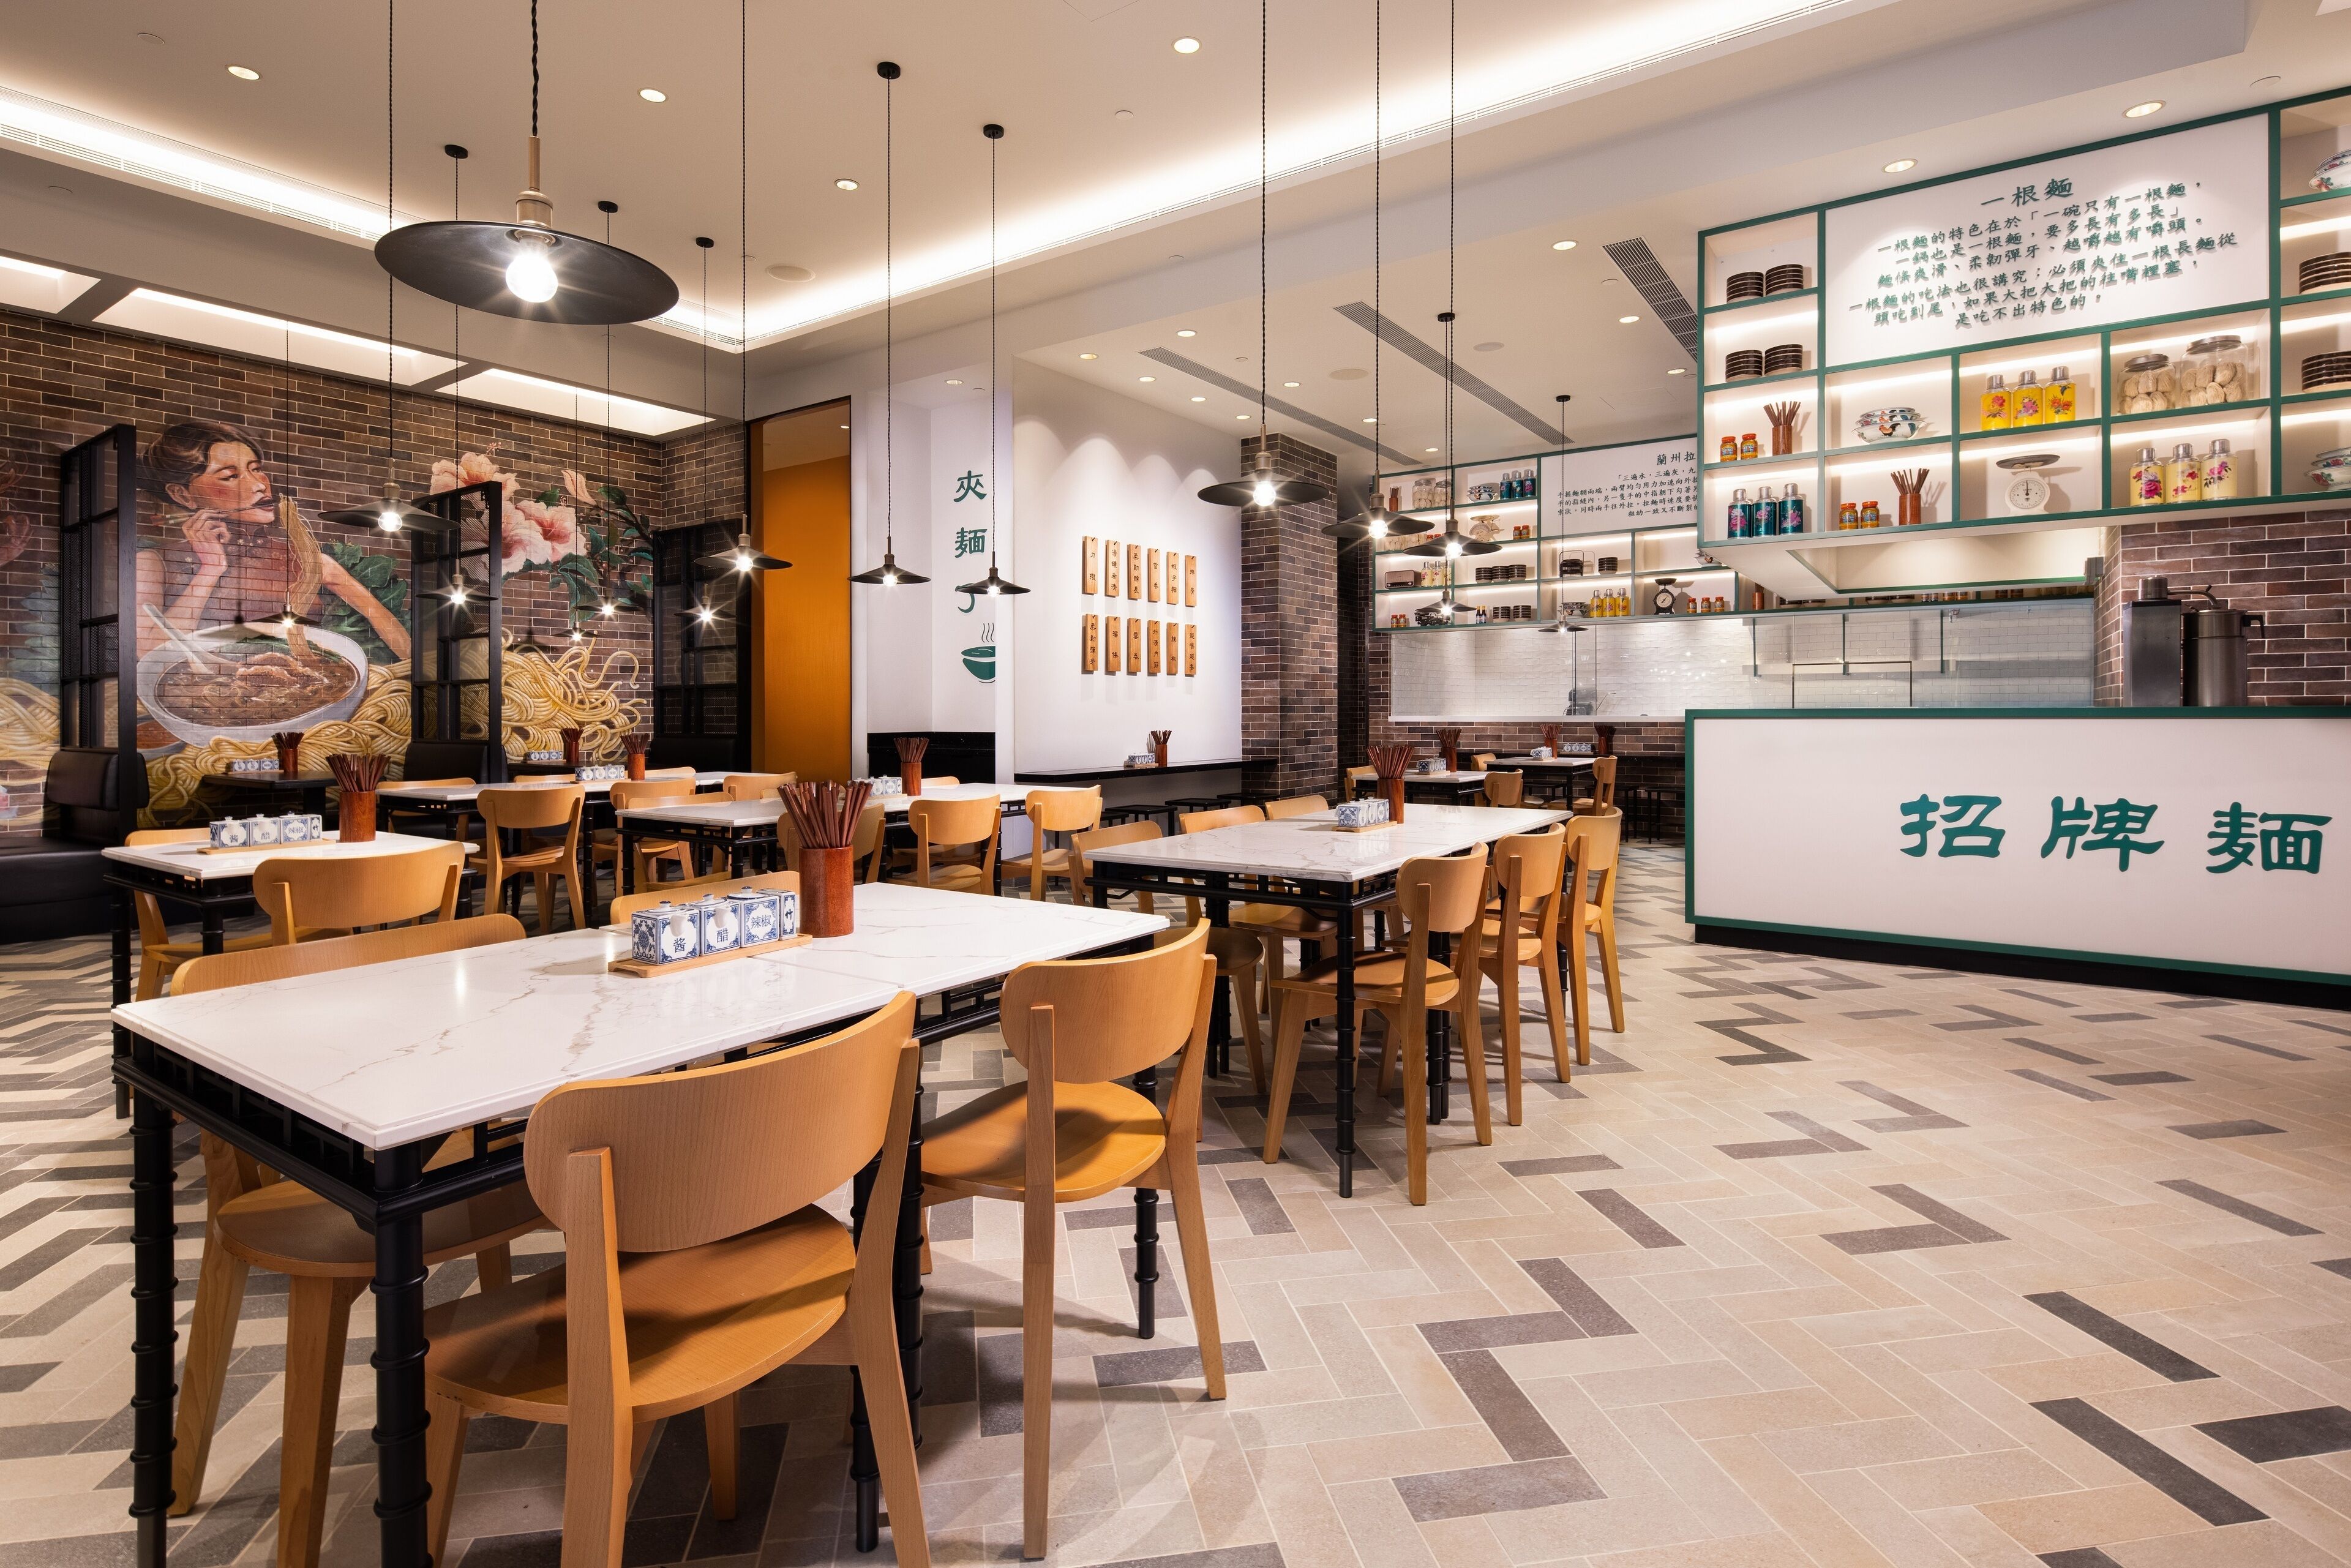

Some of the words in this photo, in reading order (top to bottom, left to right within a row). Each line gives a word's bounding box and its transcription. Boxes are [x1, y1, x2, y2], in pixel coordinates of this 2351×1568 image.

[1981, 178, 2074, 207] 一根麵
[1657, 451, 1696, 465] 蘭州拉
[1900, 793, 2333, 874] 招牌麵
[751, 915, 771, 929] 辣椒
[716, 928, 729, 943] 醋
